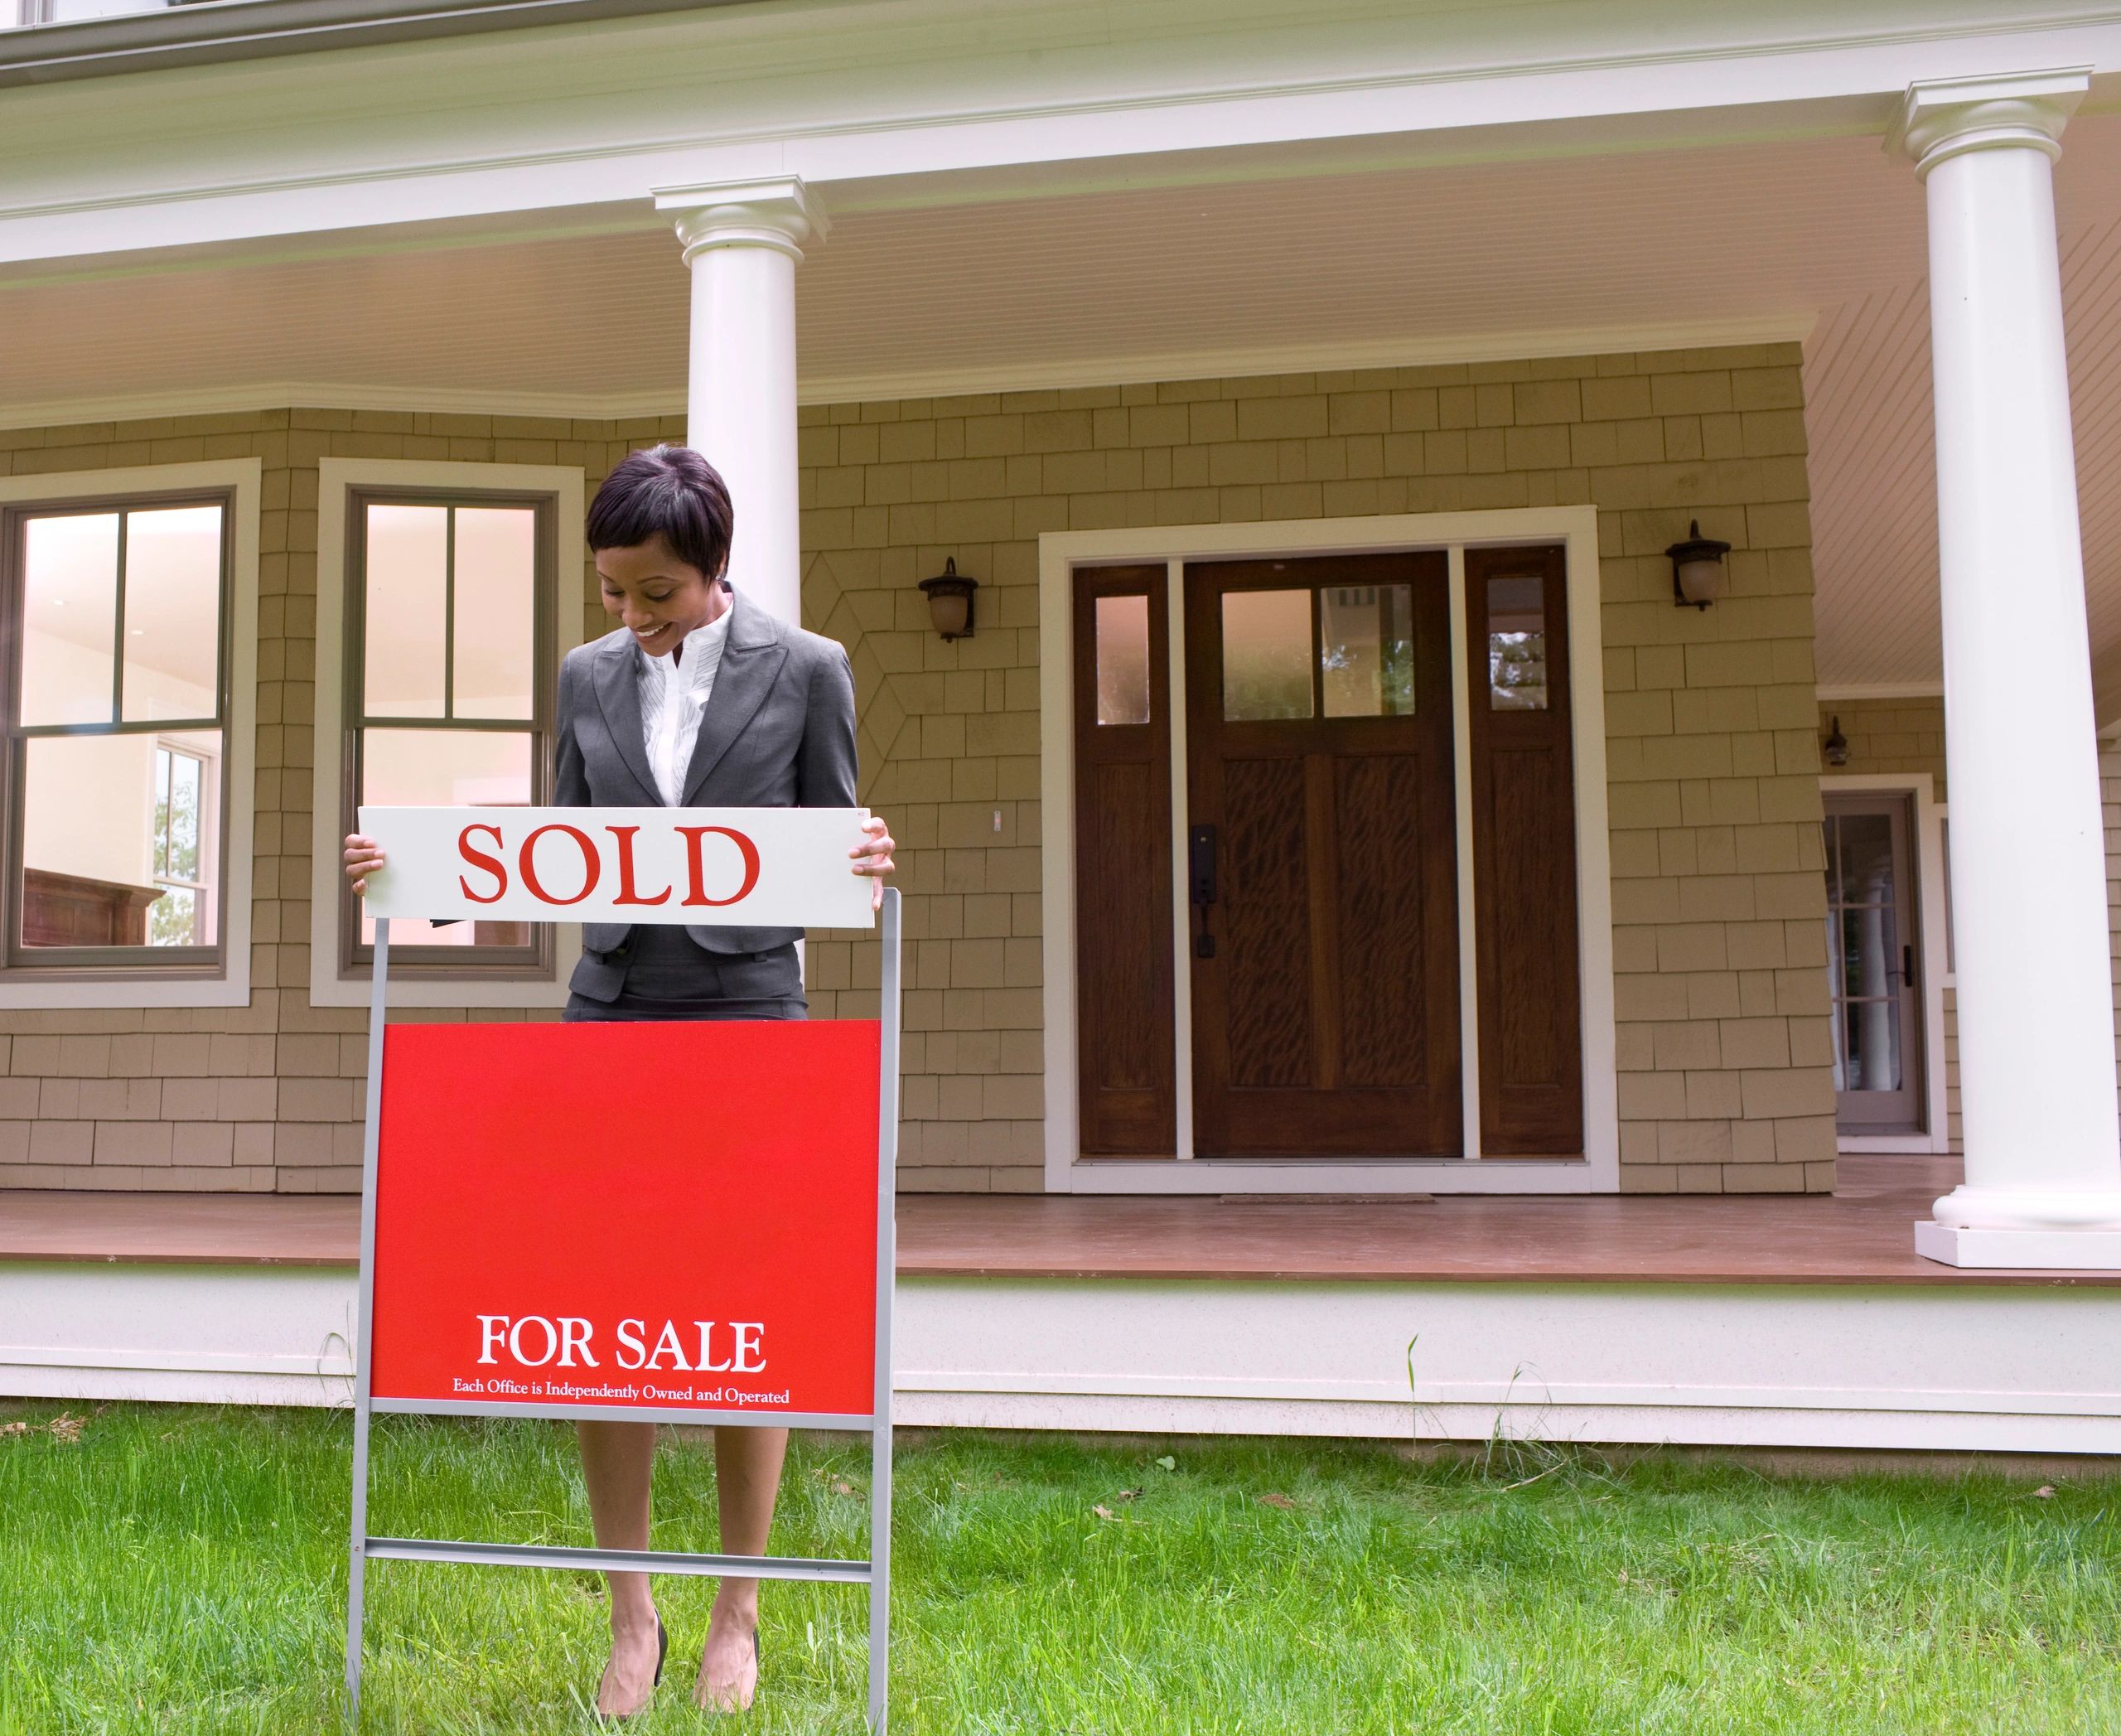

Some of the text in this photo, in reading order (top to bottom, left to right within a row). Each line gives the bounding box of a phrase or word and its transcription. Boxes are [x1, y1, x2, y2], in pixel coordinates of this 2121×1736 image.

[458, 824, 761, 907] SOLD
[476, 1314, 767, 1373] FOR SALE
[452, 1377, 790, 1406] Each Office is Independently Owned and Operated
